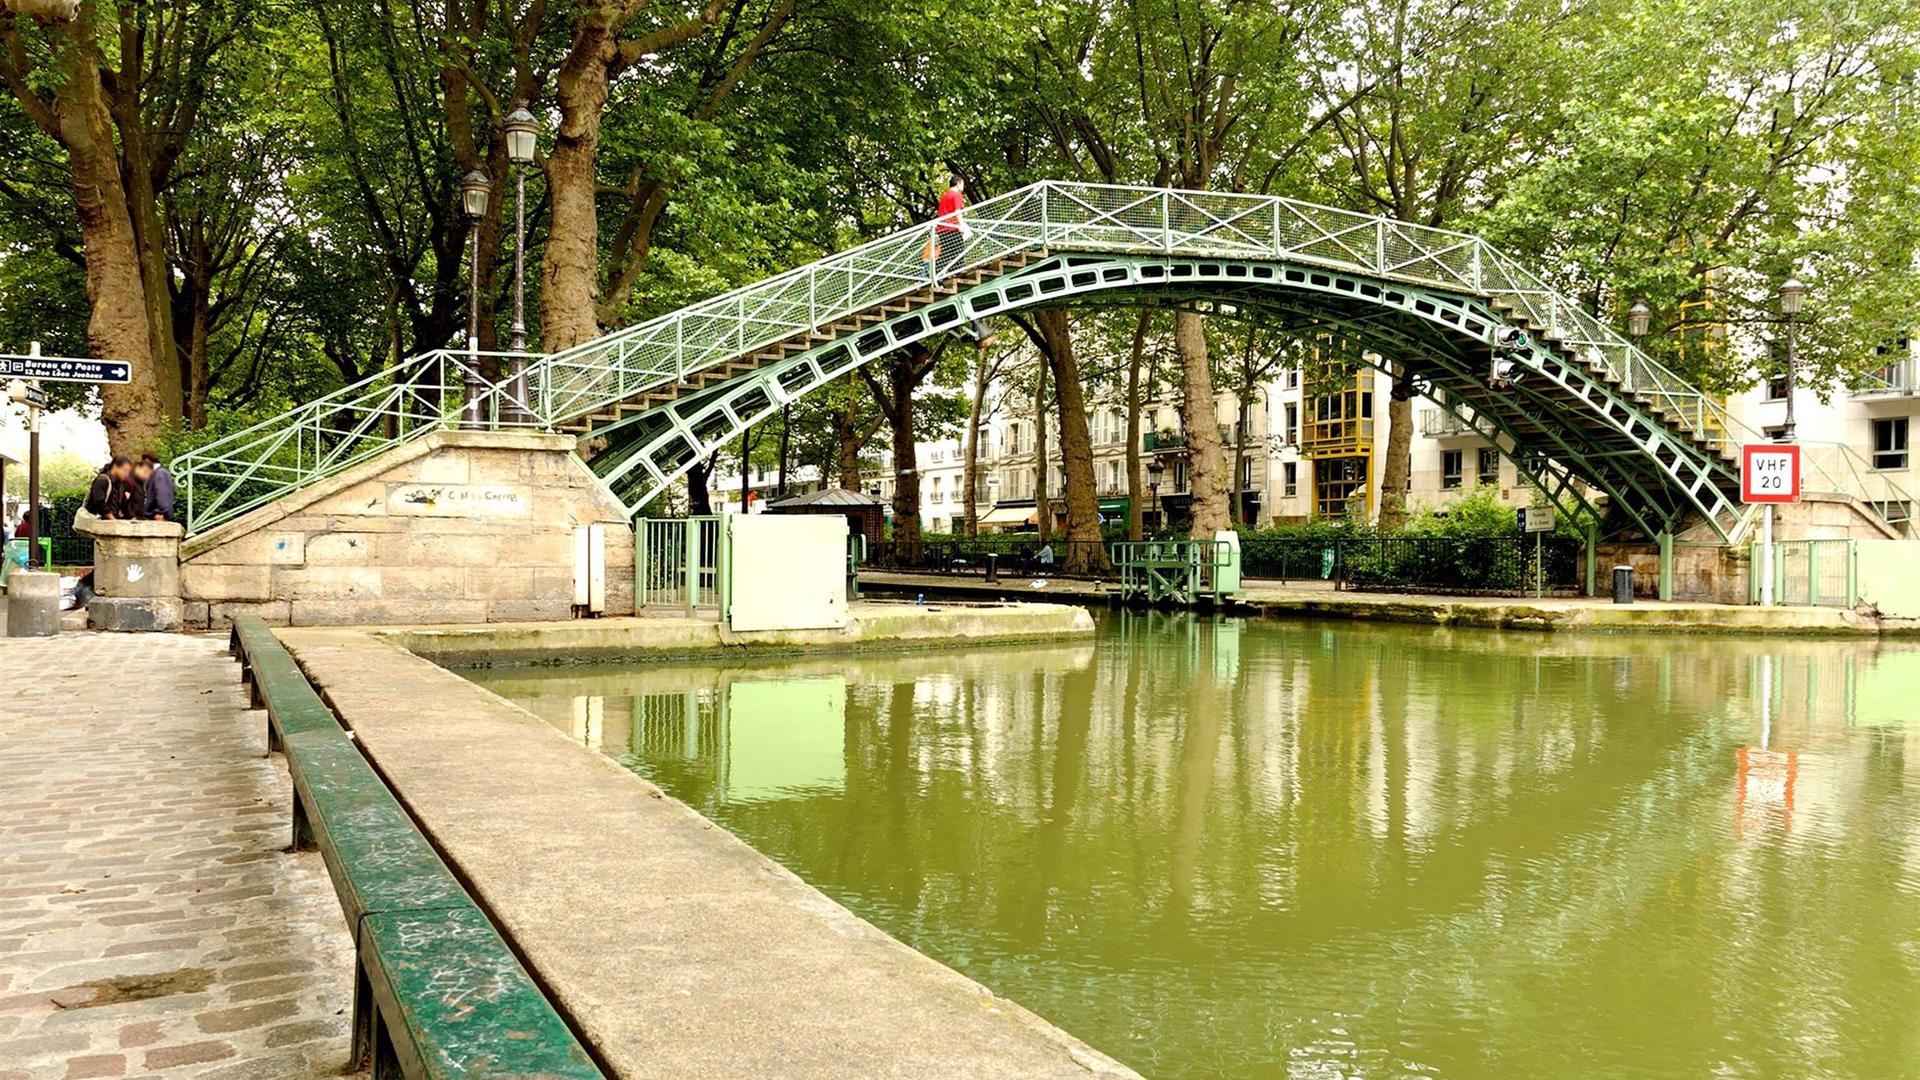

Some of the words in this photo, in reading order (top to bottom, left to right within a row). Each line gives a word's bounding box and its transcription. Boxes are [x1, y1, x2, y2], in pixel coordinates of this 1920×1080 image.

[25, 360, 58, 369] Bureau
[61, 362, 73, 370] de
[75, 363, 102, 371] Poste
[1756, 459, 1787, 471] VHF
[1762, 476, 1781, 489] 20
